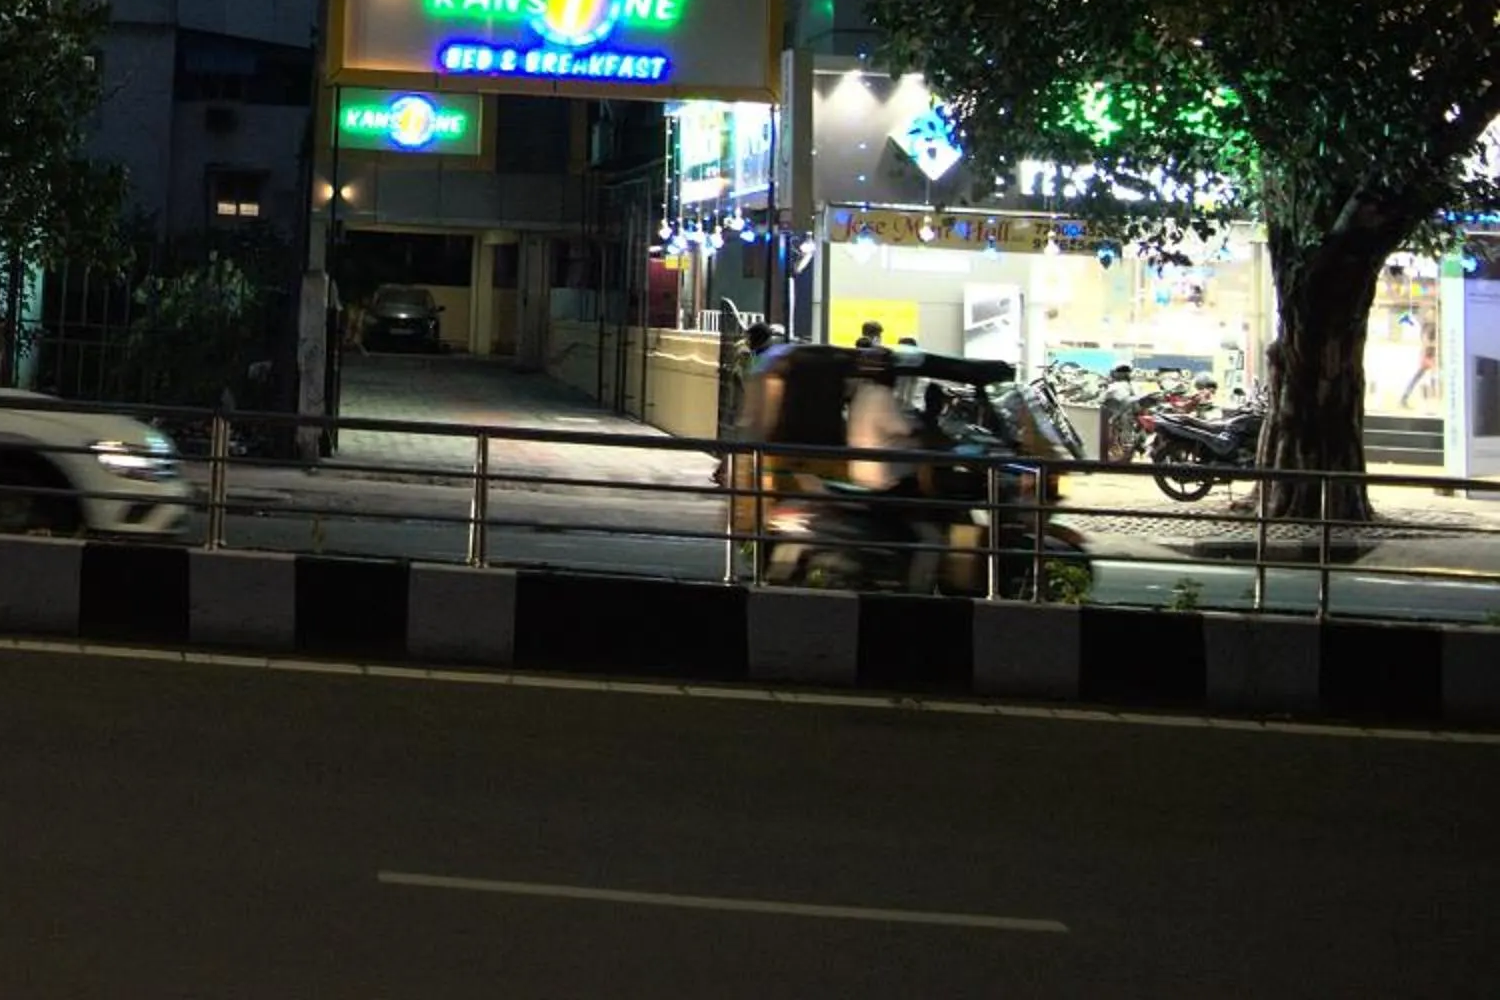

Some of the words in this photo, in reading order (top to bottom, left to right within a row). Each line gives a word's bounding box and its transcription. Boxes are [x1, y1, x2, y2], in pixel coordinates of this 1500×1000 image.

[445, 46, 493, 70] BED
[500, 49, 517, 72] &
[525, 52, 666, 79] BREAKFAST
